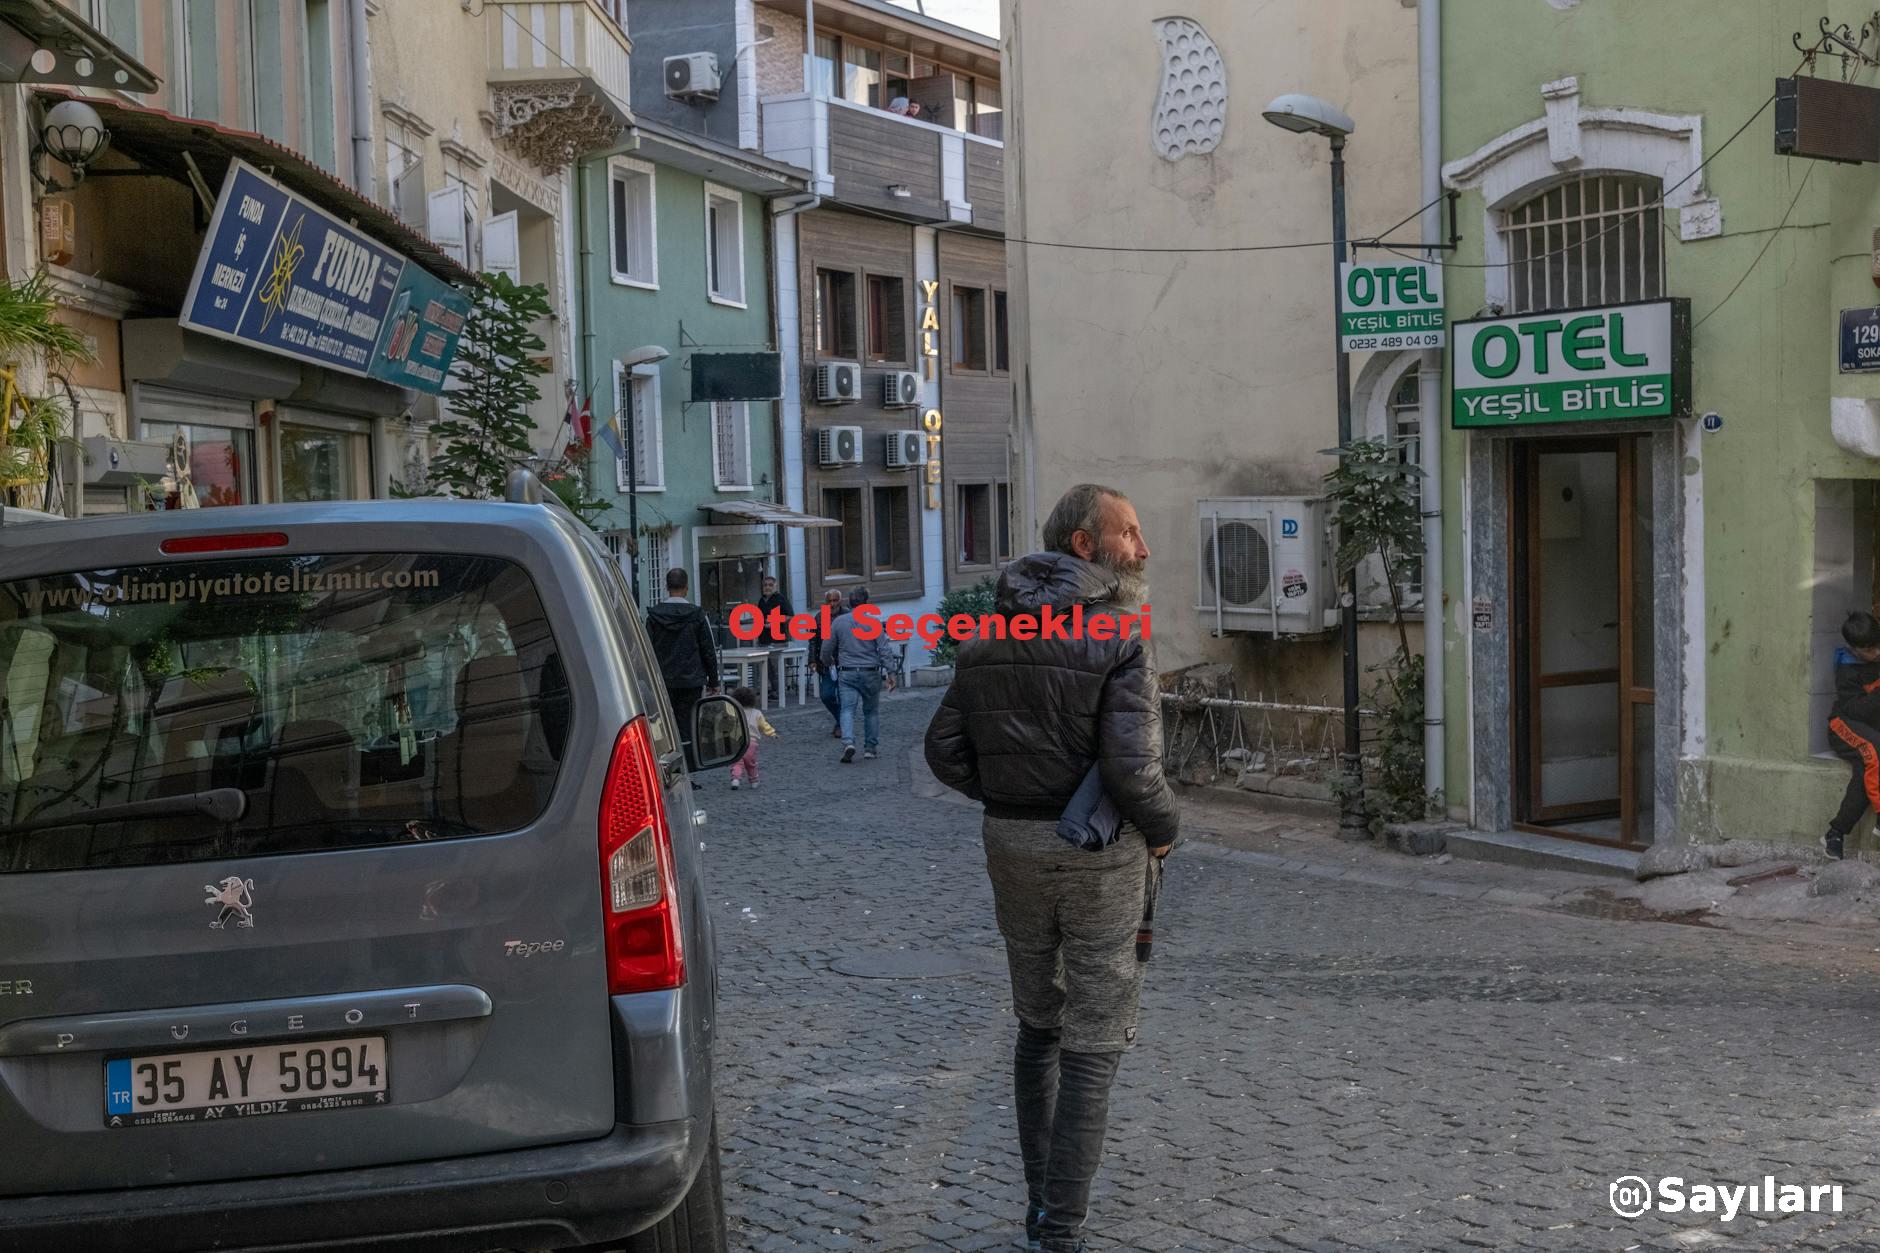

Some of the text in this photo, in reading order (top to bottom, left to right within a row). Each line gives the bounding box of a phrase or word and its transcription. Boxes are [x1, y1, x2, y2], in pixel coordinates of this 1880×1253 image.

[238, 194, 265, 225] FUNDA
[211, 262, 249, 294] MERKEZİ
[312, 228, 381, 304] FUNDA
[1347, 266, 1438, 307] OTEL
[1347, 312, 1443, 332] YEŞİL BİTLİS
[1853, 325, 1880, 344] 129
[1349, 335, 1438, 349] 0232 489 04 09
[1472, 312, 1648, 379] OTEL
[1462, 379, 1665, 420] YEŞİL BİTLİS
[924, 409, 942, 509] OTEL
[22, 564, 439, 608] www.olimpiyatotelizmir.com
[504, 939, 565, 958] Tepee
[137, 1045, 378, 1105] 35 AY 5894
[112, 1091, 130, 1104] TR
[204, 1101, 288, 1119] AY YILDIZ
